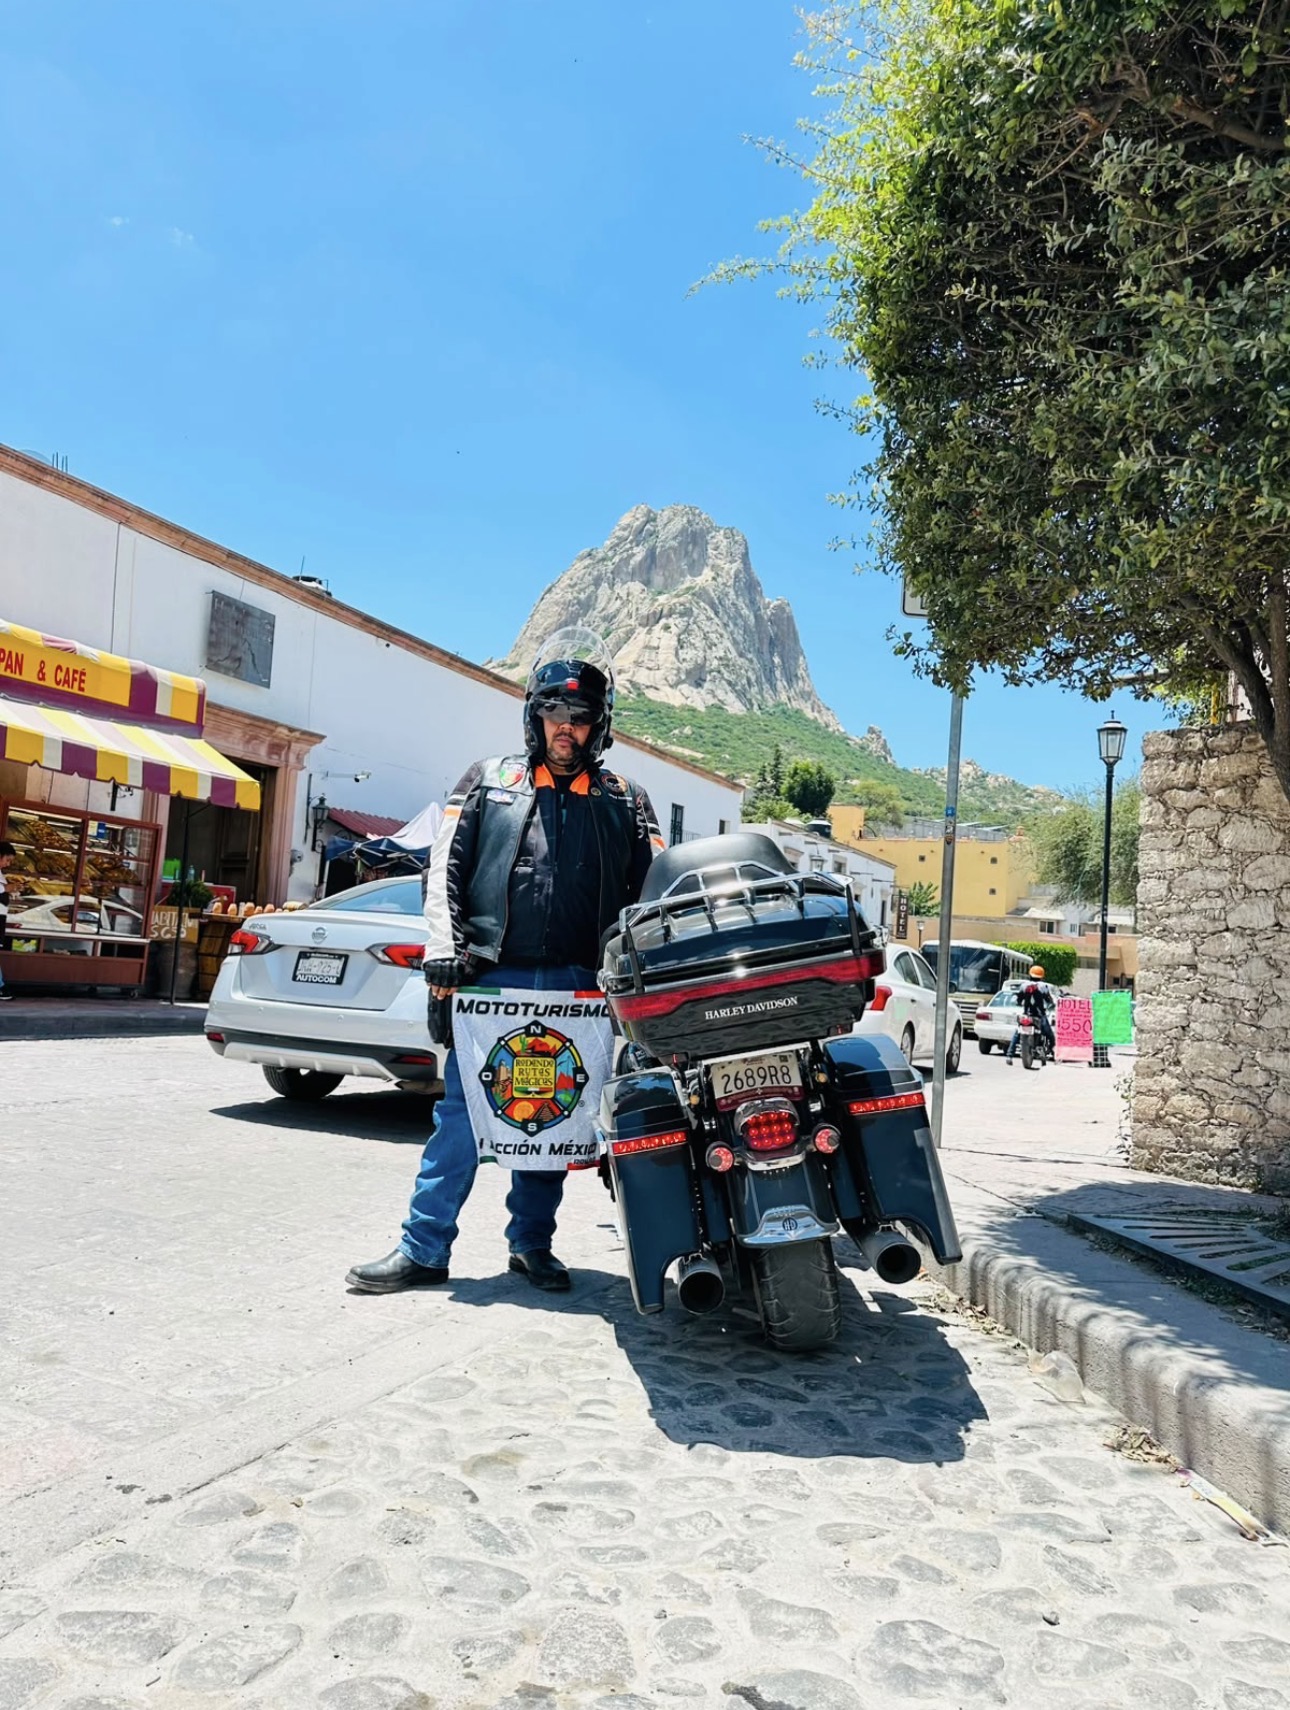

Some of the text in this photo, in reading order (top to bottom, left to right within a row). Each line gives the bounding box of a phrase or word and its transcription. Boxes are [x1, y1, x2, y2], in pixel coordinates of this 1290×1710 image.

[0, 648, 87, 692] PAN & CAFÉ
[296, 973, 337, 984] AUTOCOM
[456, 998, 610, 1018] MOTOTURISMO
[705, 996, 799, 1020] HARLEY DAVIDSON
[1057, 999, 1092, 1010] HOTEL
[530, 1025, 542, 1034] N
[576, 1073, 586, 1083] E
[721, 1065, 792, 1094] 2689R8
[527, 1122, 538, 1132] S
